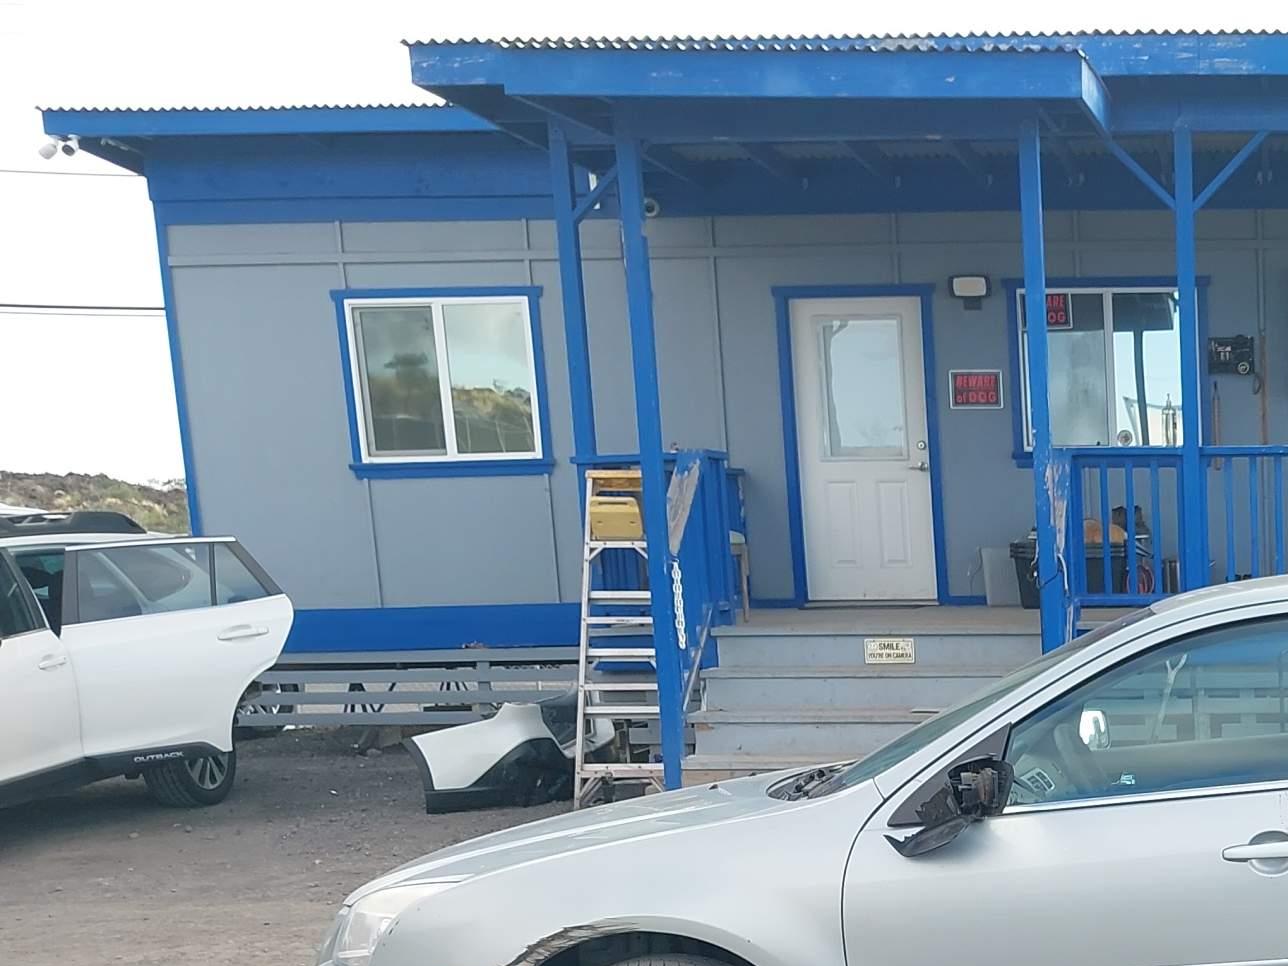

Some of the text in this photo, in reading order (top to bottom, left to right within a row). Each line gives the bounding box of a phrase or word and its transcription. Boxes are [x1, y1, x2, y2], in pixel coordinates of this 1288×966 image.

[1047, 295, 1065, 309] ARE
[1048, 312, 1066, 323] OG
[956, 375, 995, 388] BEWARE
[957, 391, 997, 403] of DOG
[134, 751, 184, 762] OUTBACK
